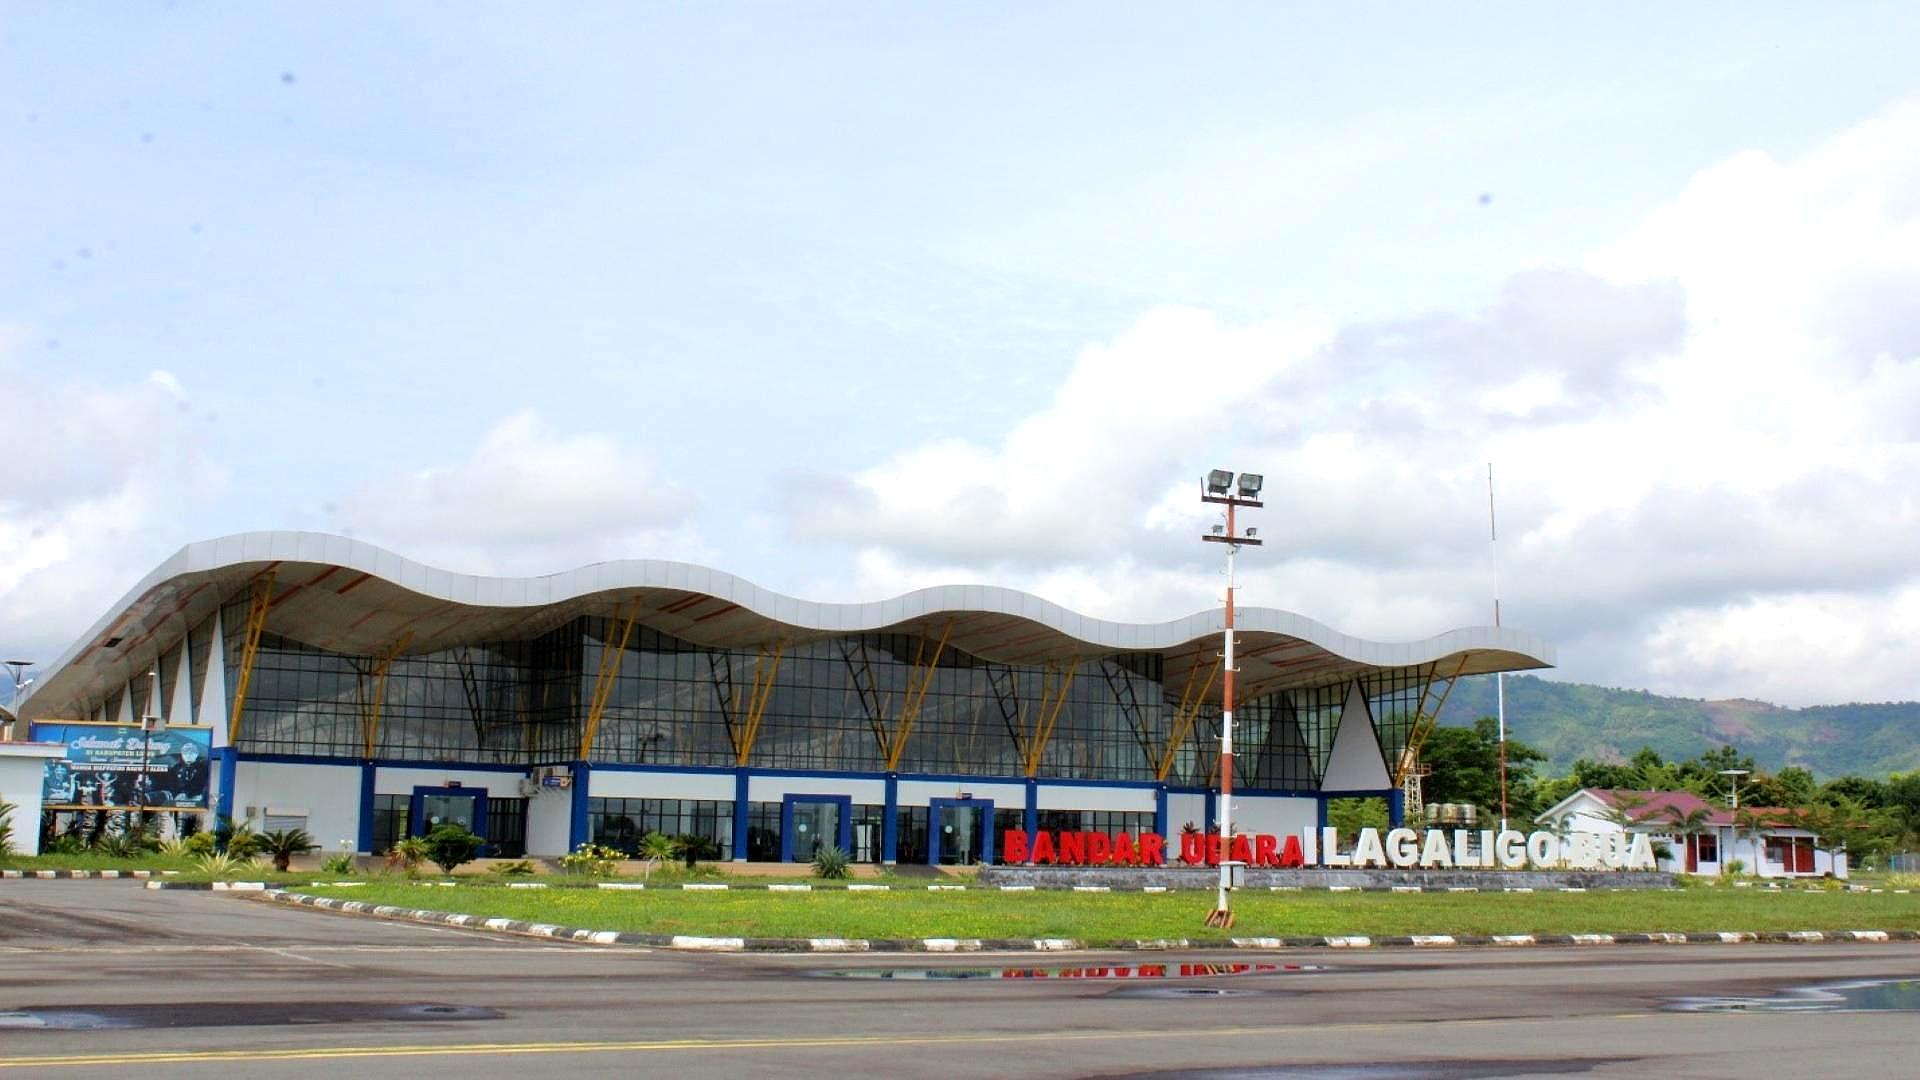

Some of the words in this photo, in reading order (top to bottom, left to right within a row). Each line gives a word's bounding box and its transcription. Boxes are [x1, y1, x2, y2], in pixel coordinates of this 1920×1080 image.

[1004, 829, 1166, 866] BANDAR
[1180, 832, 1304, 866] UDARA
[1567, 831, 1657, 869] BUA
